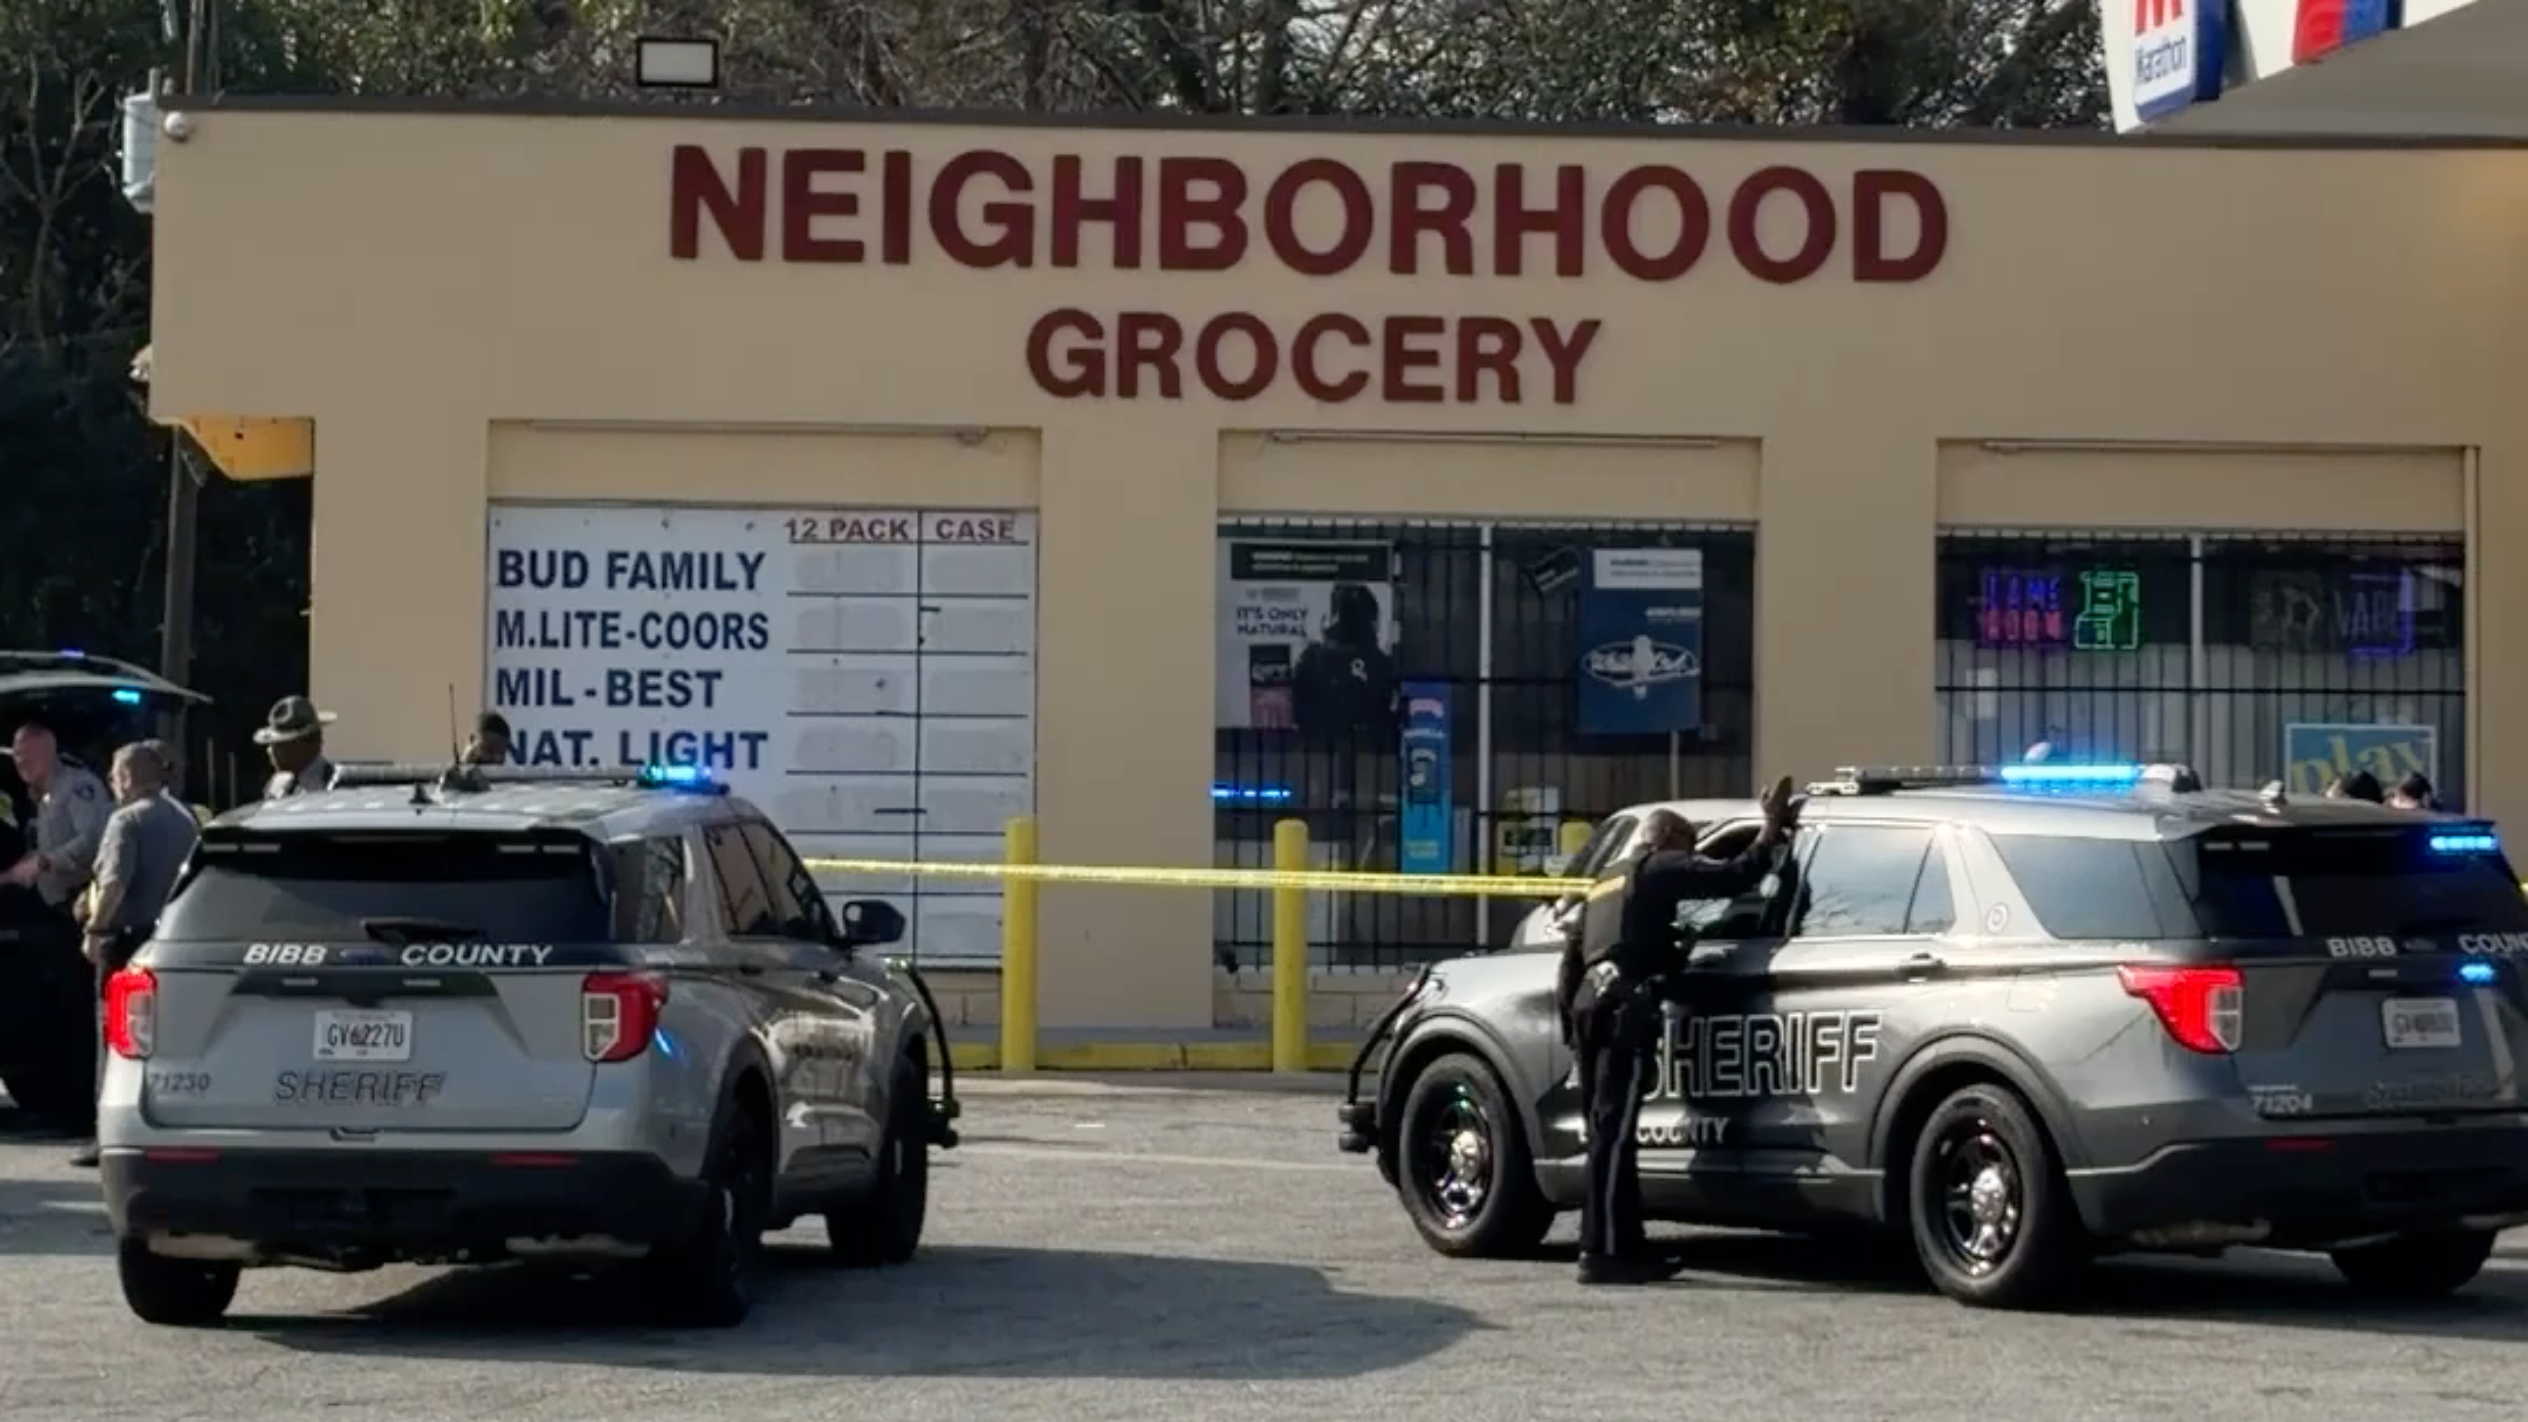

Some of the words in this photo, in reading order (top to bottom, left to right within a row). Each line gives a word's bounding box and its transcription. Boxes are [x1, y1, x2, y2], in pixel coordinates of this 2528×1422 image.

[2135, 36, 2187, 84] Marathon
[670, 145, 1949, 284] NEIGHBORHOOD
[1026, 308, 1602, 404] GROCERY
[786, 519, 818, 540] 12
[830, 518, 910, 541] PACK
[935, 519, 1014, 541] CASE
[498, 549, 590, 590] BUD
[606, 551, 766, 591] FAMILY
[497, 609, 770, 651] M.LITE-COORS
[502, 731, 599, 767] NAT.
[618, 731, 769, 770] LIGHT
[243, 943, 328, 966] BIBB
[400, 944, 553, 967] COUNTY
[2326, 937, 2398, 958] BIBB
[274, 1069, 447, 1106] SHERIFF
[1636, 1117, 1730, 1145] COUNTY
